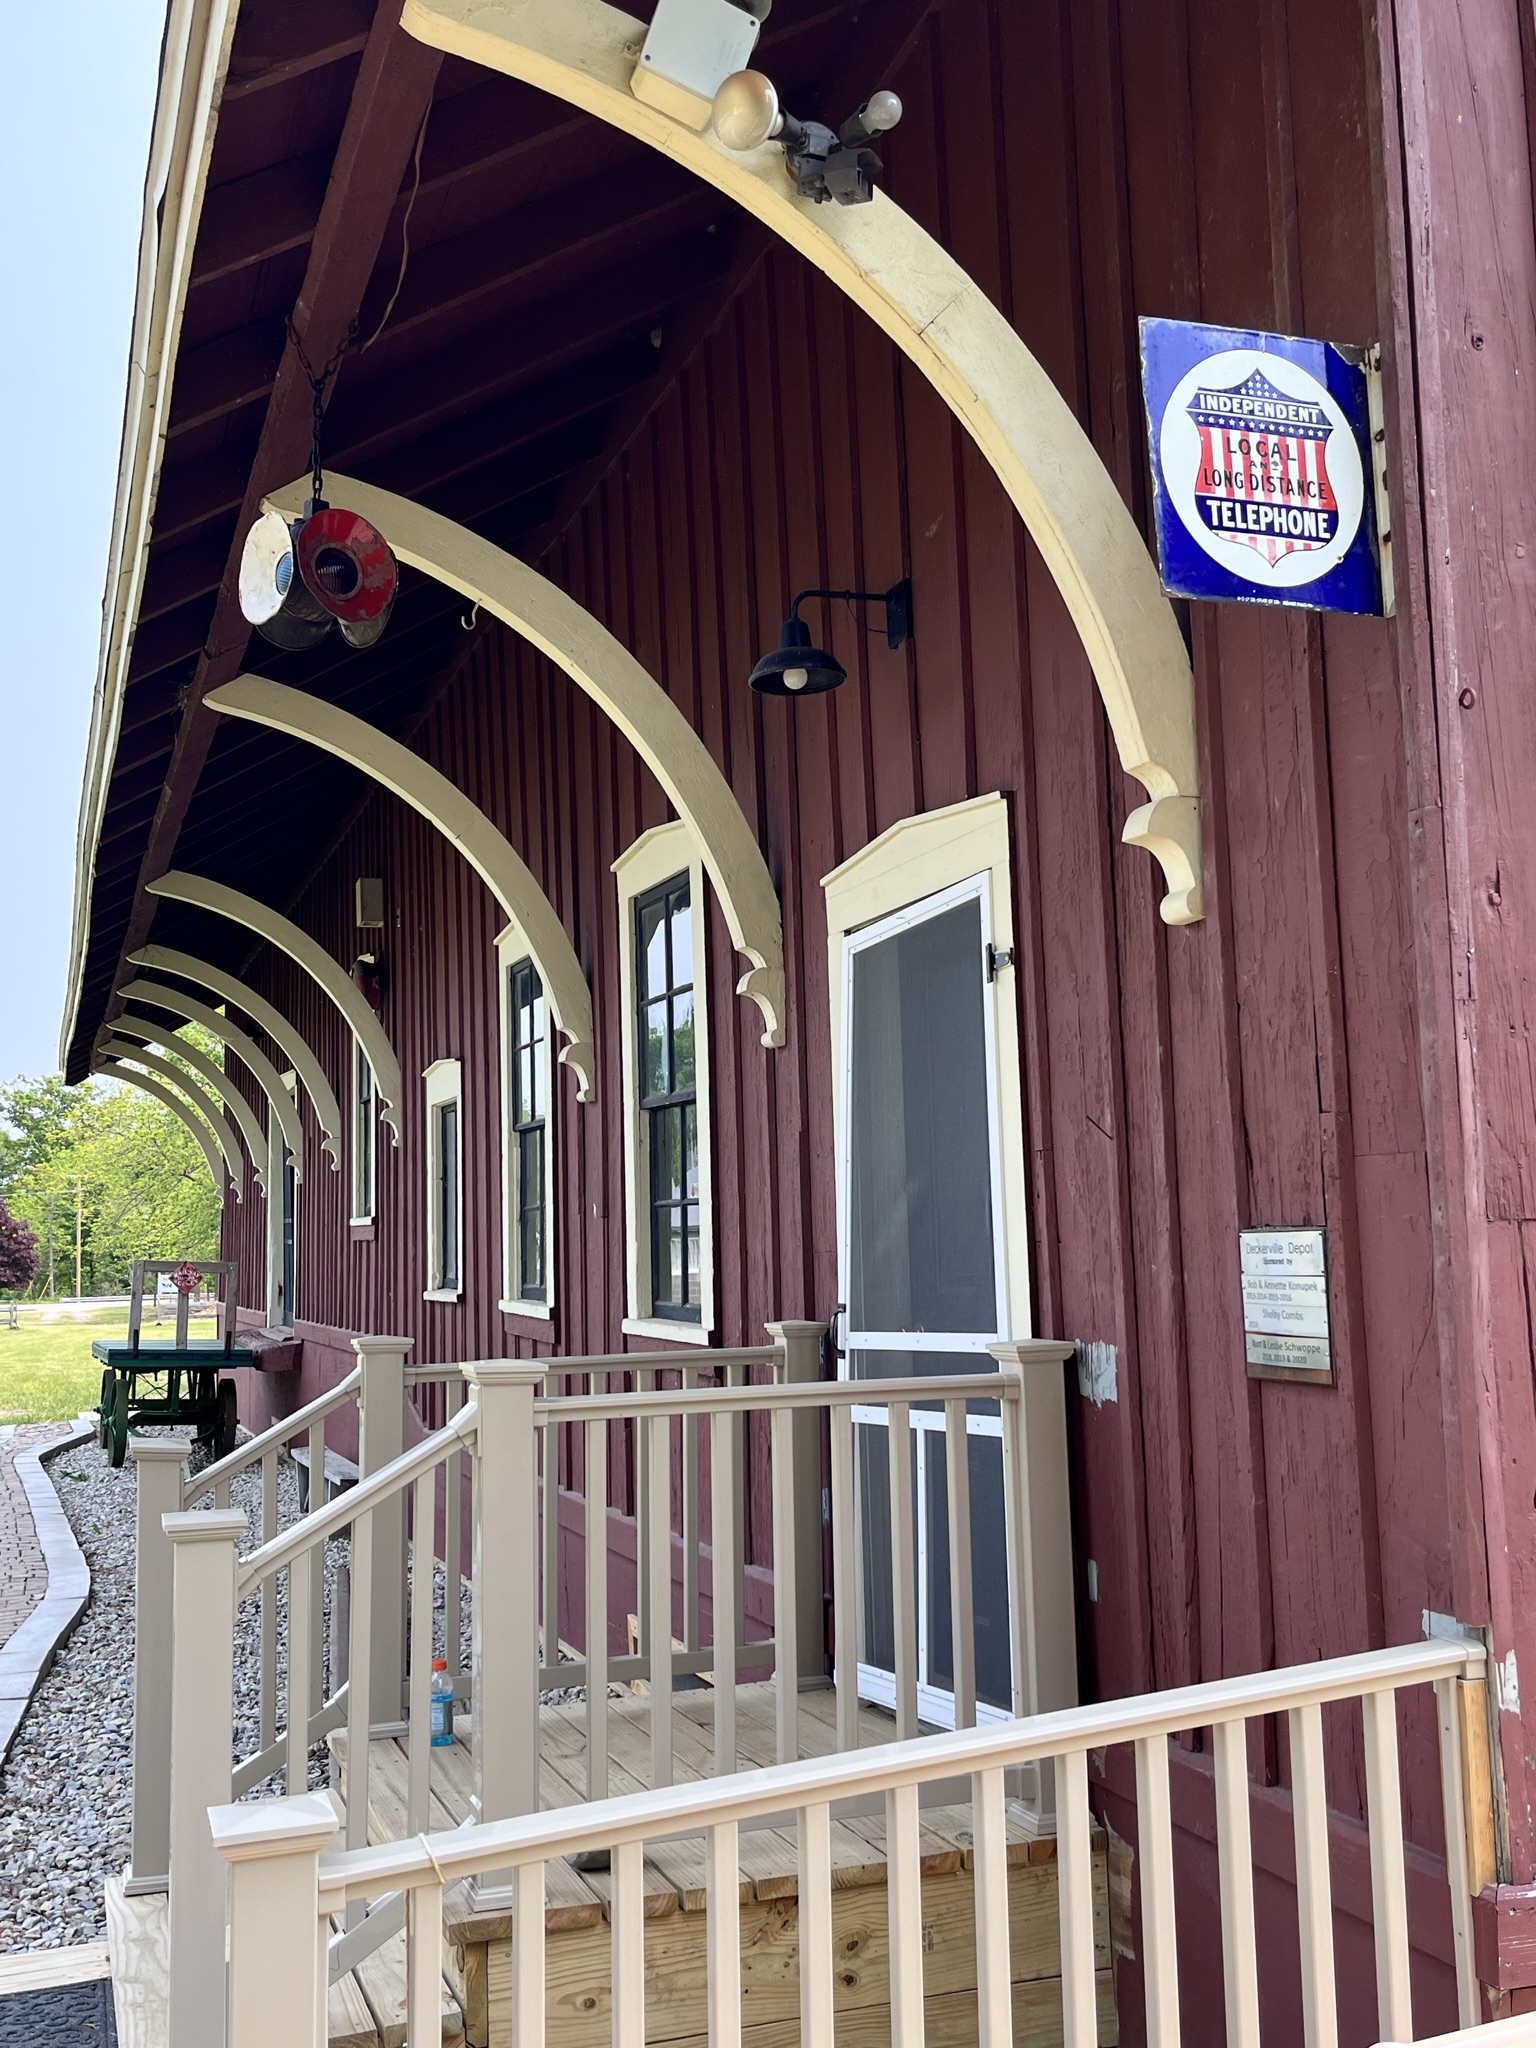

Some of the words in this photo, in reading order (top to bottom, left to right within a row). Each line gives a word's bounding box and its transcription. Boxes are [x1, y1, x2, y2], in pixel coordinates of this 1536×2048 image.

[1199, 394, 1319, 423] INDEPENDENT
[1226, 436, 1297, 461] LOCAL
[1203, 467, 1244, 489] LONG
[1249, 473, 1328, 500] DISTANCE
[1206, 499, 1331, 539] TELEPHONE
[1246, 1242, 1283, 1255] Deckerville
[1288, 1242, 1314, 1256] Depot
[1286, 1258, 1293, 1266] by
[1281, 1310, 1304, 1321] Combs
